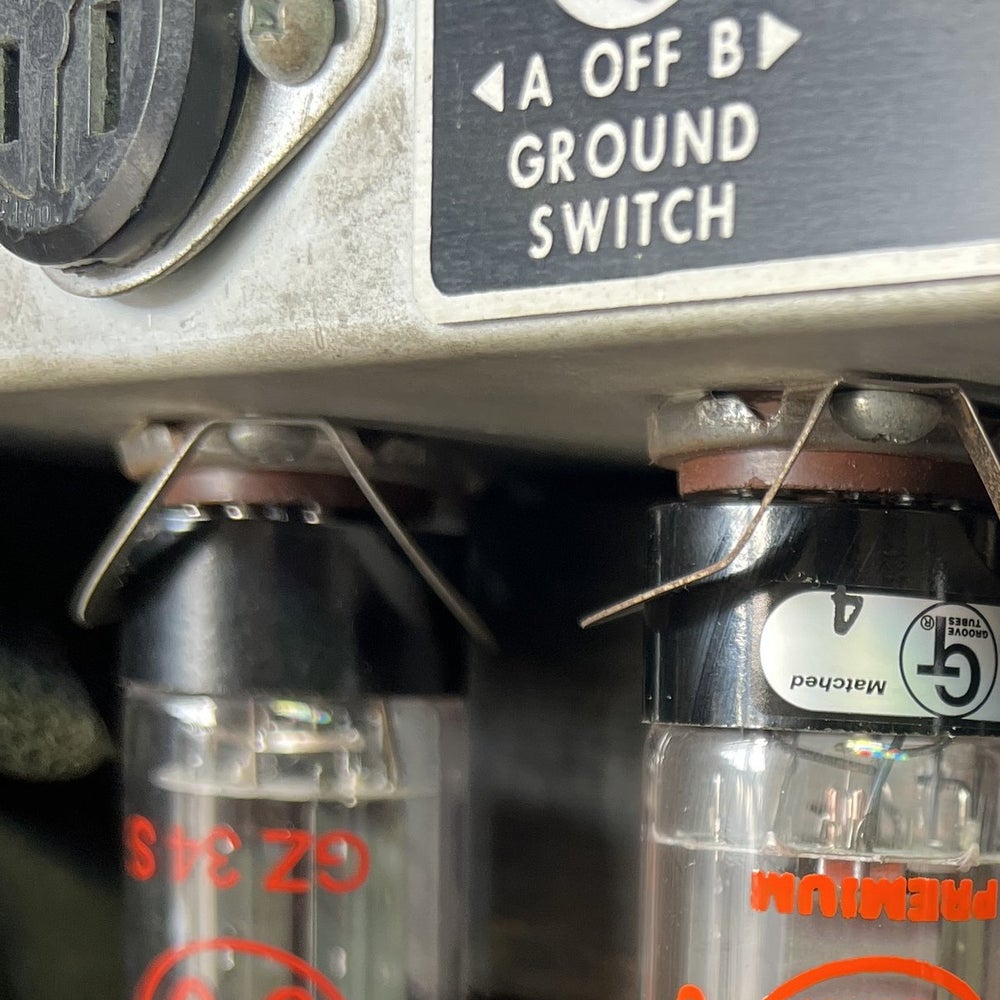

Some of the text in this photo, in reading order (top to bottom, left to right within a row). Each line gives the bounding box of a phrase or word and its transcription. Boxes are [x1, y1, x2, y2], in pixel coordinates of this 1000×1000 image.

[518, 17, 743, 111] A OFF B
[507, 102, 759, 189] GROUND
[528, 181, 736, 259] SWITCH
[947, 626, 988, 640] GROOVE
[948, 616, 981, 628] TUBES
[790, 673, 887, 696] Matched
[261, 827, 371, 893] GZ
[750, 870, 998, 922] PREMIUM
